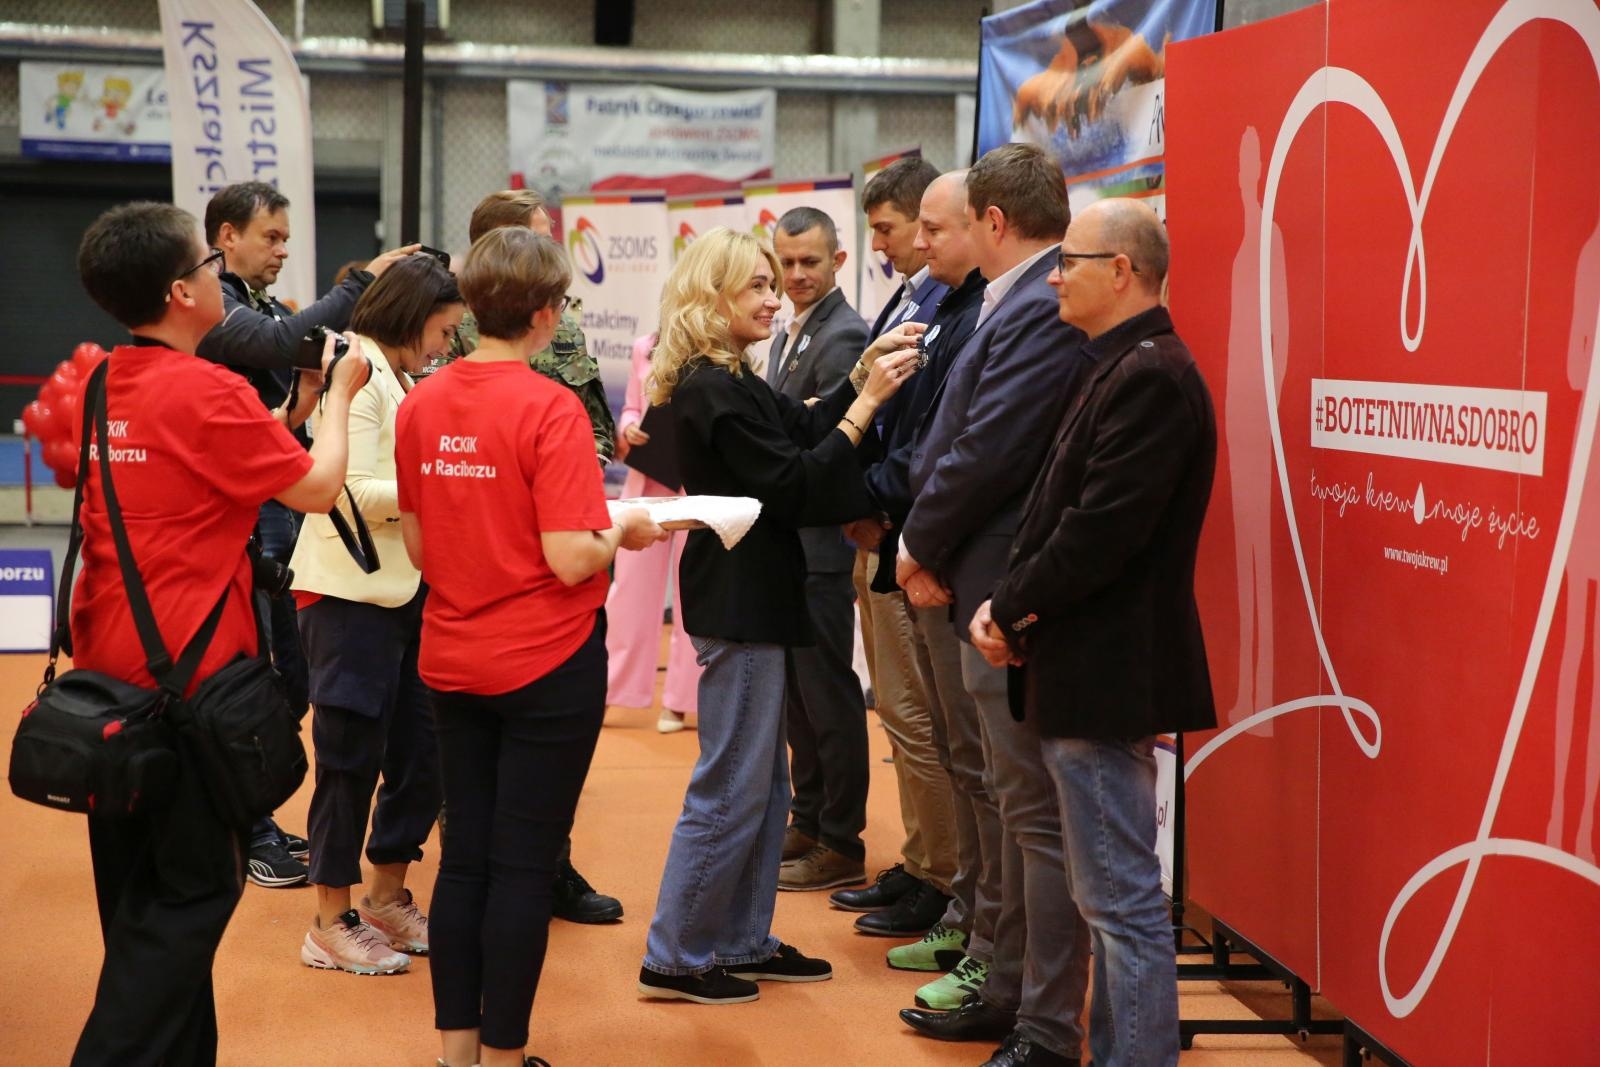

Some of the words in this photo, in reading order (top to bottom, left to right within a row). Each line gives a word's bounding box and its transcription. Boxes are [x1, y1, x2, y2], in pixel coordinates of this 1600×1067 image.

[608, 235, 658, 260] ZSOMS
[581, 309, 640, 336] ztałcimy
[592, 338, 634, 361] Mistrz
[94, 420, 129, 438] KiK
[1316, 396, 1538, 455] #BOTETNIWNASDOBRO
[89, 443, 147, 464] Rborzu
[439, 435, 478, 454] RCKiK
[435, 458, 497, 479] Racibozu
[1310, 468, 1360, 518] twoja
[1366, 471, 1414, 513] krew
[1425, 499, 1482, 542] moje
[1487, 505, 1540, 550] życie
[1383, 546, 1449, 576] www.twojakrew.pl
[0, 566, 45, 582] orzu
